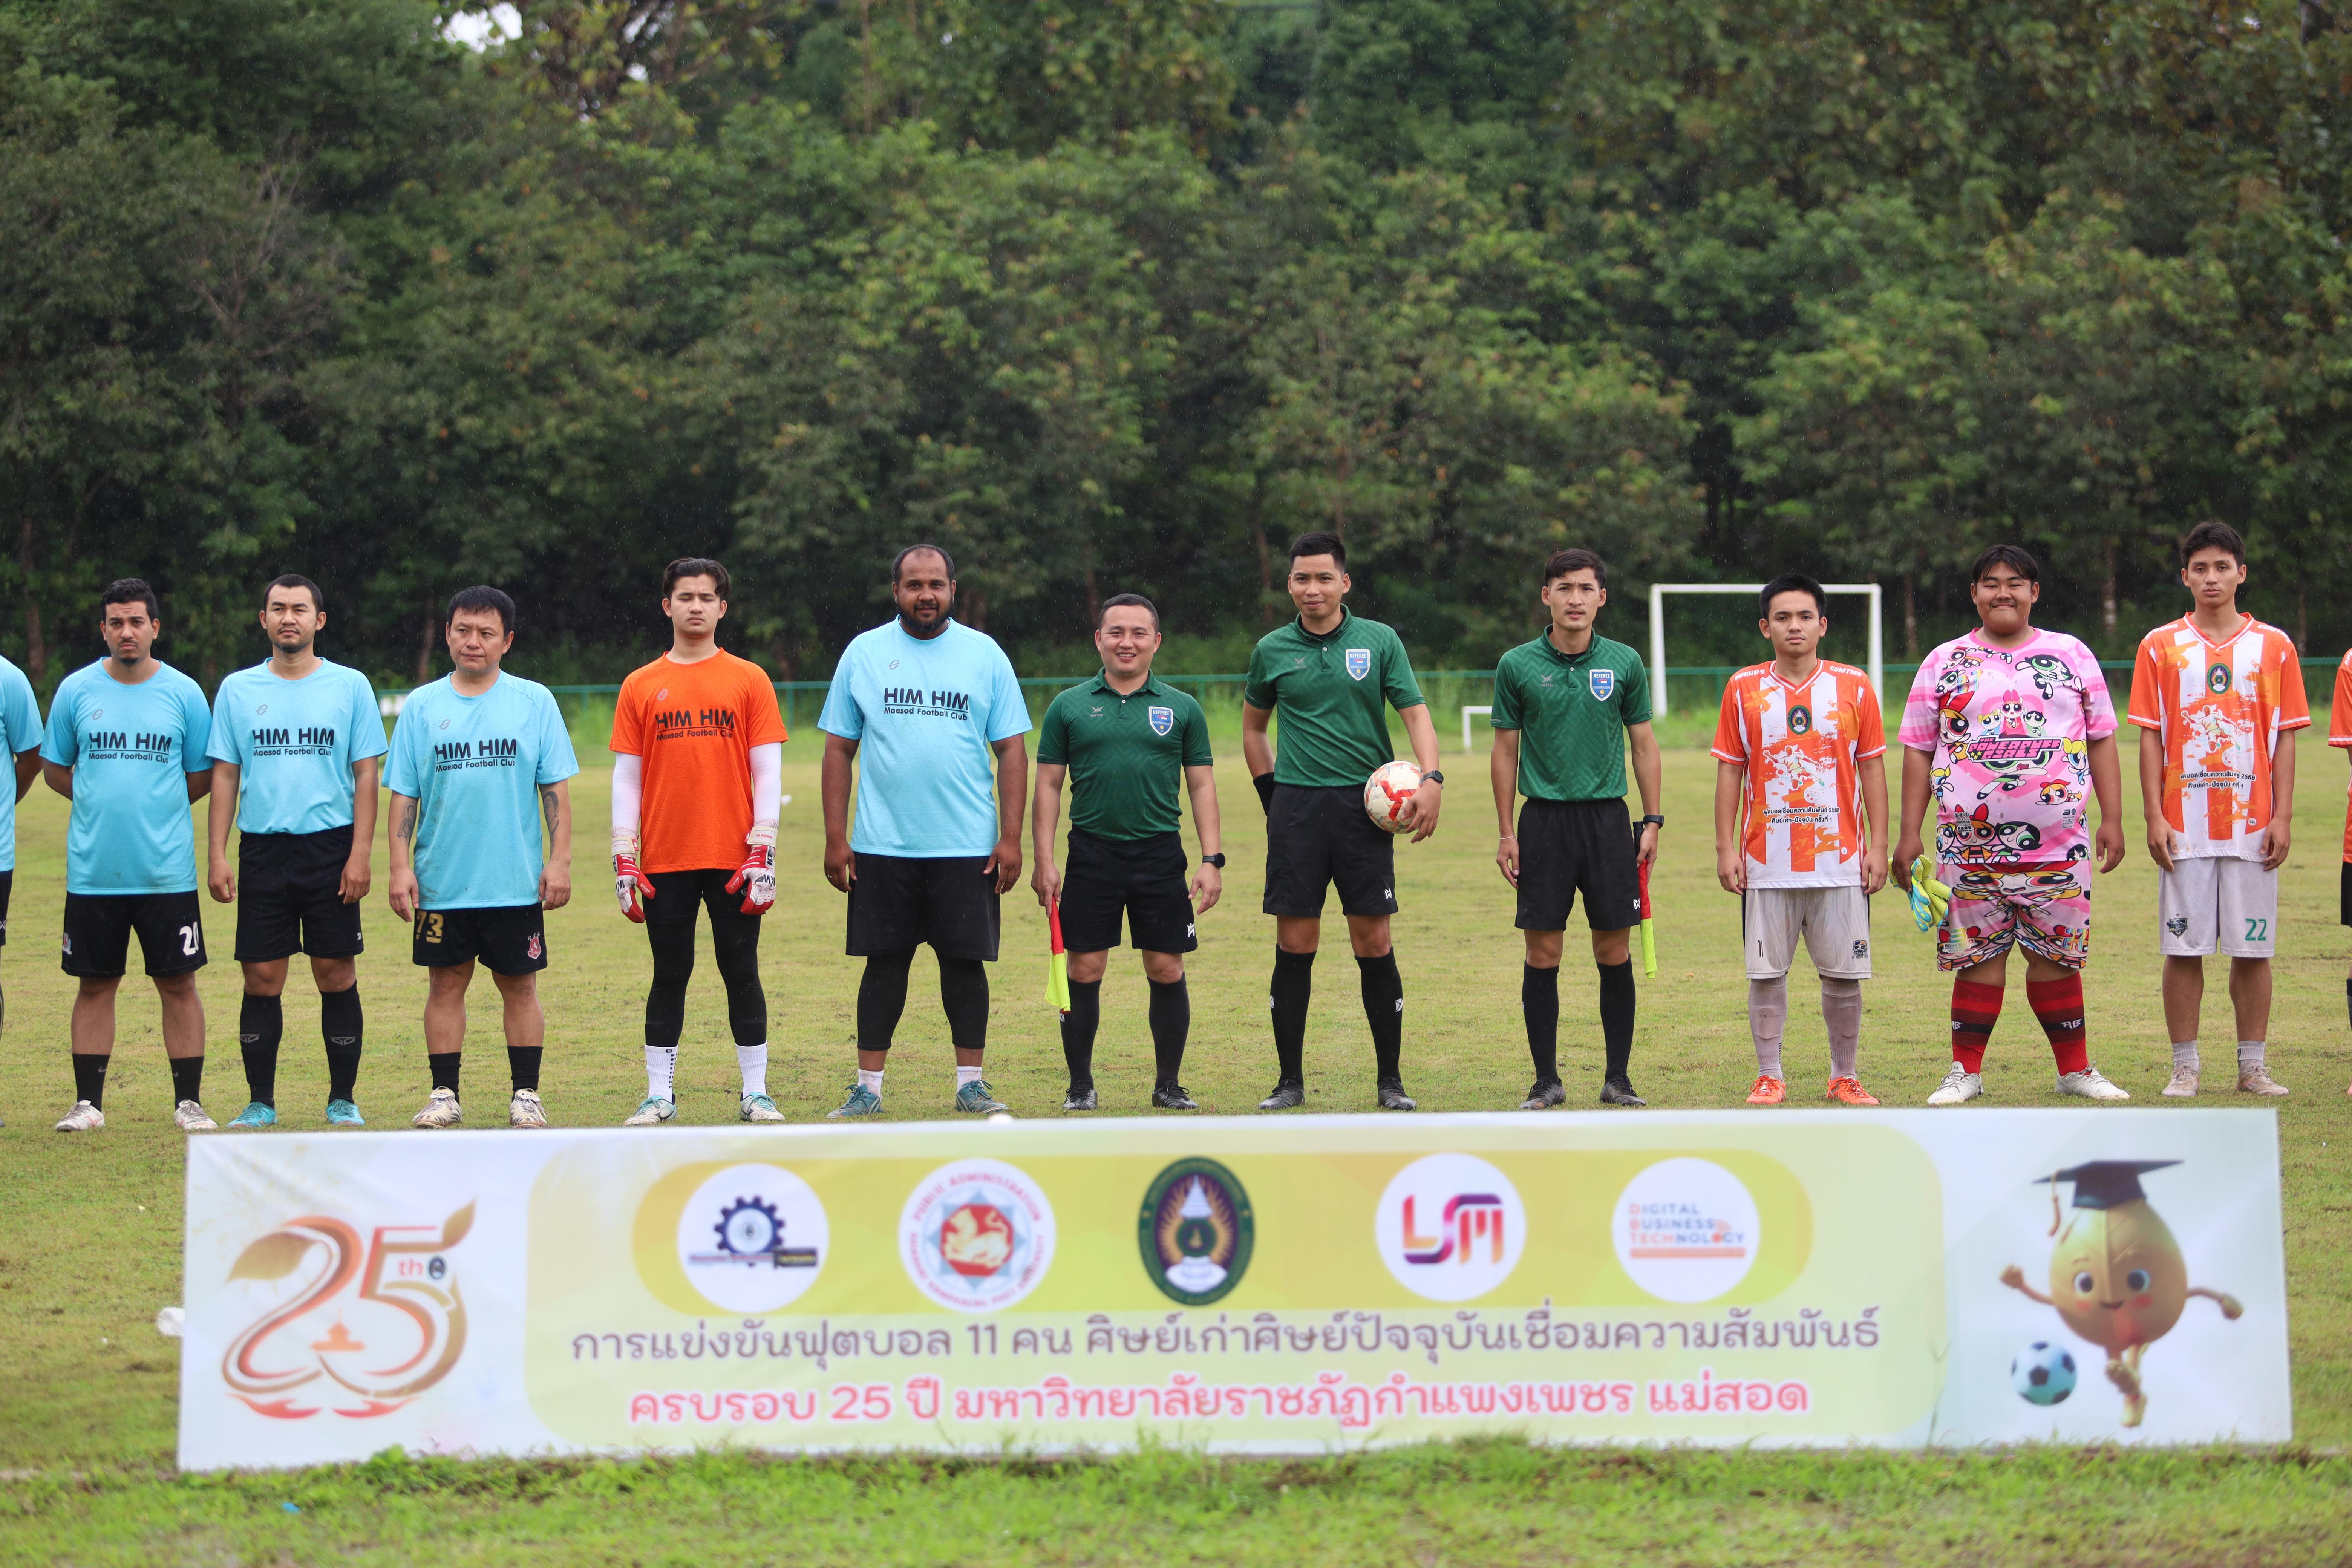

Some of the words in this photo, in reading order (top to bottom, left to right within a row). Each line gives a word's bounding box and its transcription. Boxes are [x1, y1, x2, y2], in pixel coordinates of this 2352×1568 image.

[1829, 666, 1862, 677] COMTMS
[884, 687, 923, 705] HIM
[932, 690, 968, 710] HIM
[655, 710, 692, 730] HIM
[700, 709, 734, 729] HIM
[917, 708, 948, 717] Football
[951, 712, 968, 721] Club
[89, 732, 127, 749] HIM
[136, 732, 172, 753] HIM
[252, 728, 290, 745] HIM
[299, 727, 334, 746] HIM
[657, 731, 683, 741] Maesod
[1968, 739, 2061, 752] POWERPUFF
[156, 755, 168, 763] Club
[435, 742, 471, 761] HIM
[479, 738, 516, 756] HIM
[436, 763, 462, 772] Maesod
[466, 759, 498, 768] Football
[416, 910, 444, 943] 73
[2245, 918, 2267, 941] 22
[179, 921, 199, 956] 20
[2061, 928, 2087, 951] 27
[913, 1184, 945, 1222] PUBLIC
[950, 1173, 1041, 1222] ADMINISTRATION
[1629, 1203, 1700, 1215] DIGITAL
[1629, 1218, 1716, 1230] BUSINESS
[399, 1259, 423, 1276] th
[573, 1319, 951, 1371] การแข่งขันฟุตบอล
[968, 1323, 997, 1355] 11
[1013, 1327, 1072, 1355] คน
[1087, 1297, 1880, 1365] ศิษย์เก่าศิษย์ปัจจุบันเชื่อมความสัมพันธ์
[631, 1390, 816, 1422] ครบรอบ
[831, 1384, 891, 1420] 25
[906, 1376, 939, 1419] ปี
[956, 1373, 1634, 1427] มหาวิทยาลัยราชภัฏกำแพงเพชร
[1649, 1369, 1808, 1412] แม่สอด
